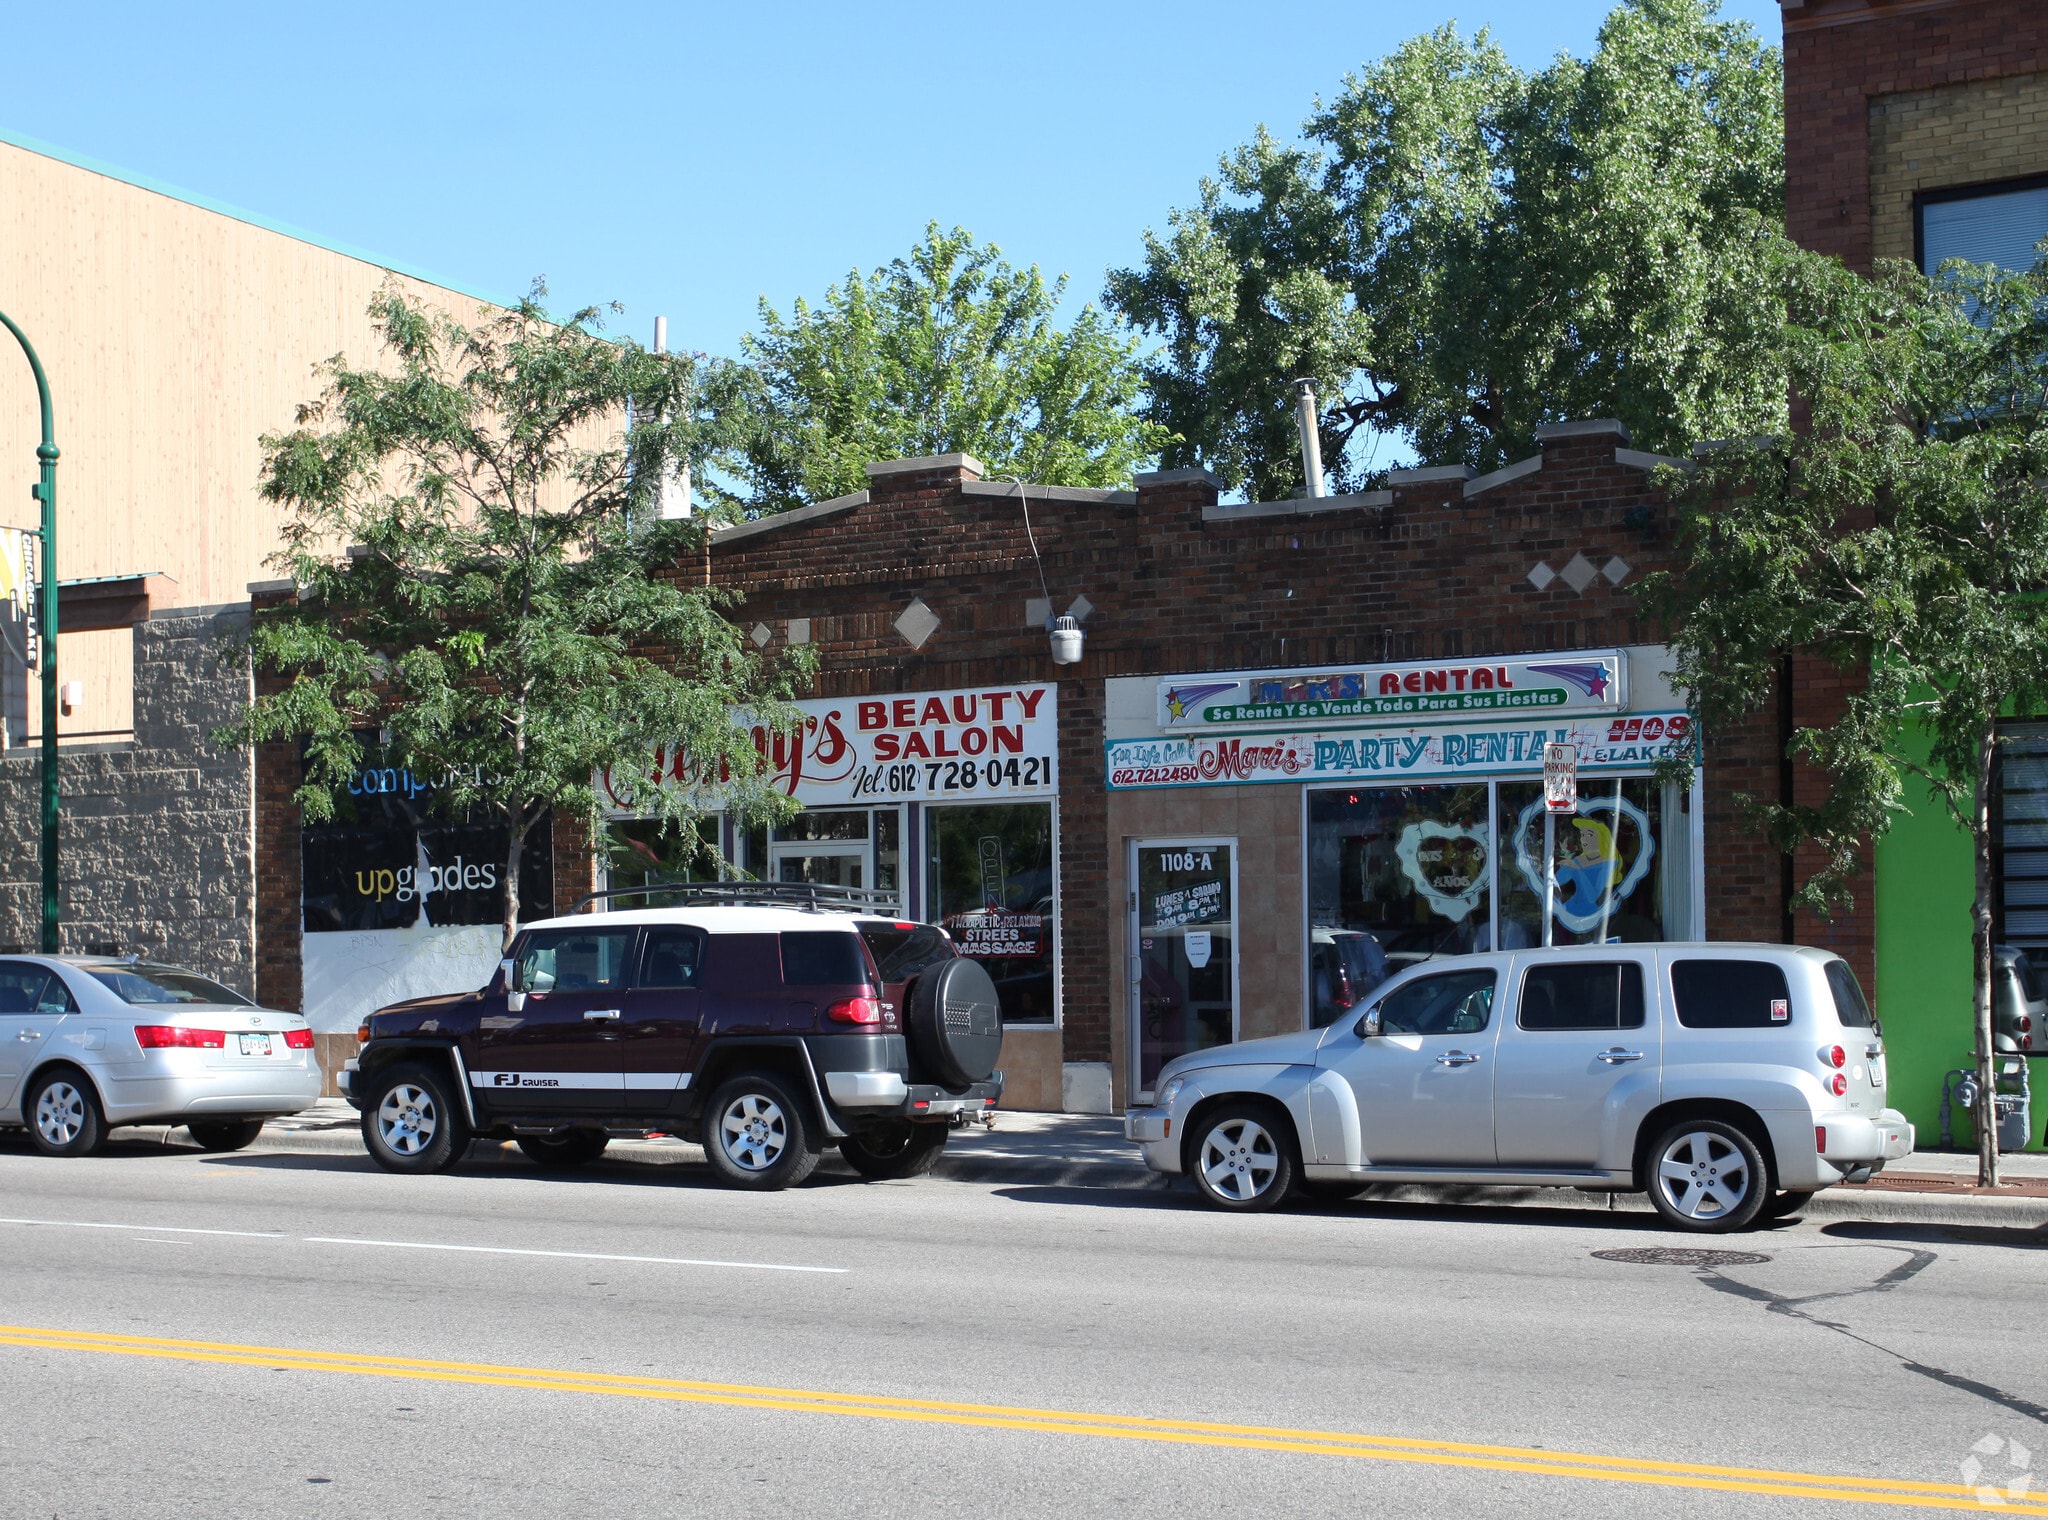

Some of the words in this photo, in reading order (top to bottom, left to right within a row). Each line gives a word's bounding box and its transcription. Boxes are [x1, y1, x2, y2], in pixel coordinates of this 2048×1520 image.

[1379, 666, 1515, 695] RENTAL
[858, 689, 1046, 730] BEAUTY
[1212, 707, 1231, 720] Se
[1236, 705, 1282, 719] Renta
[1284, 706, 1294, 717] Y
[1300, 704, 1318, 716] Se
[1321, 700, 1372, 715] Vende
[1374, 700, 1414, 712] Todo
[1418, 698, 1458, 710] Para
[1463, 695, 1491, 708] Sus
[1496, 692, 1559, 706] Fiestas
[1607, 716, 1690, 742] 1108
[873, 724, 1025, 761] SALON
[1314, 735, 1431, 771] PARTY
[1551, 748, 1563, 760] NO
[1198, 738, 1311, 781] Maris
[1545, 762, 1574, 774] PARKING
[852, 764, 885, 799] Tel.
[885, 763, 921, 793] (612)
[1161, 852, 1213, 873] 1108-A
[1155, 891, 1185, 909] LUNES
[954, 941, 1036, 955] MASSAGE
[965, 928, 1020, 942] STREES
[493, 1073, 520, 1086] FJ
[522, 1079, 560, 1087] CRUISER
